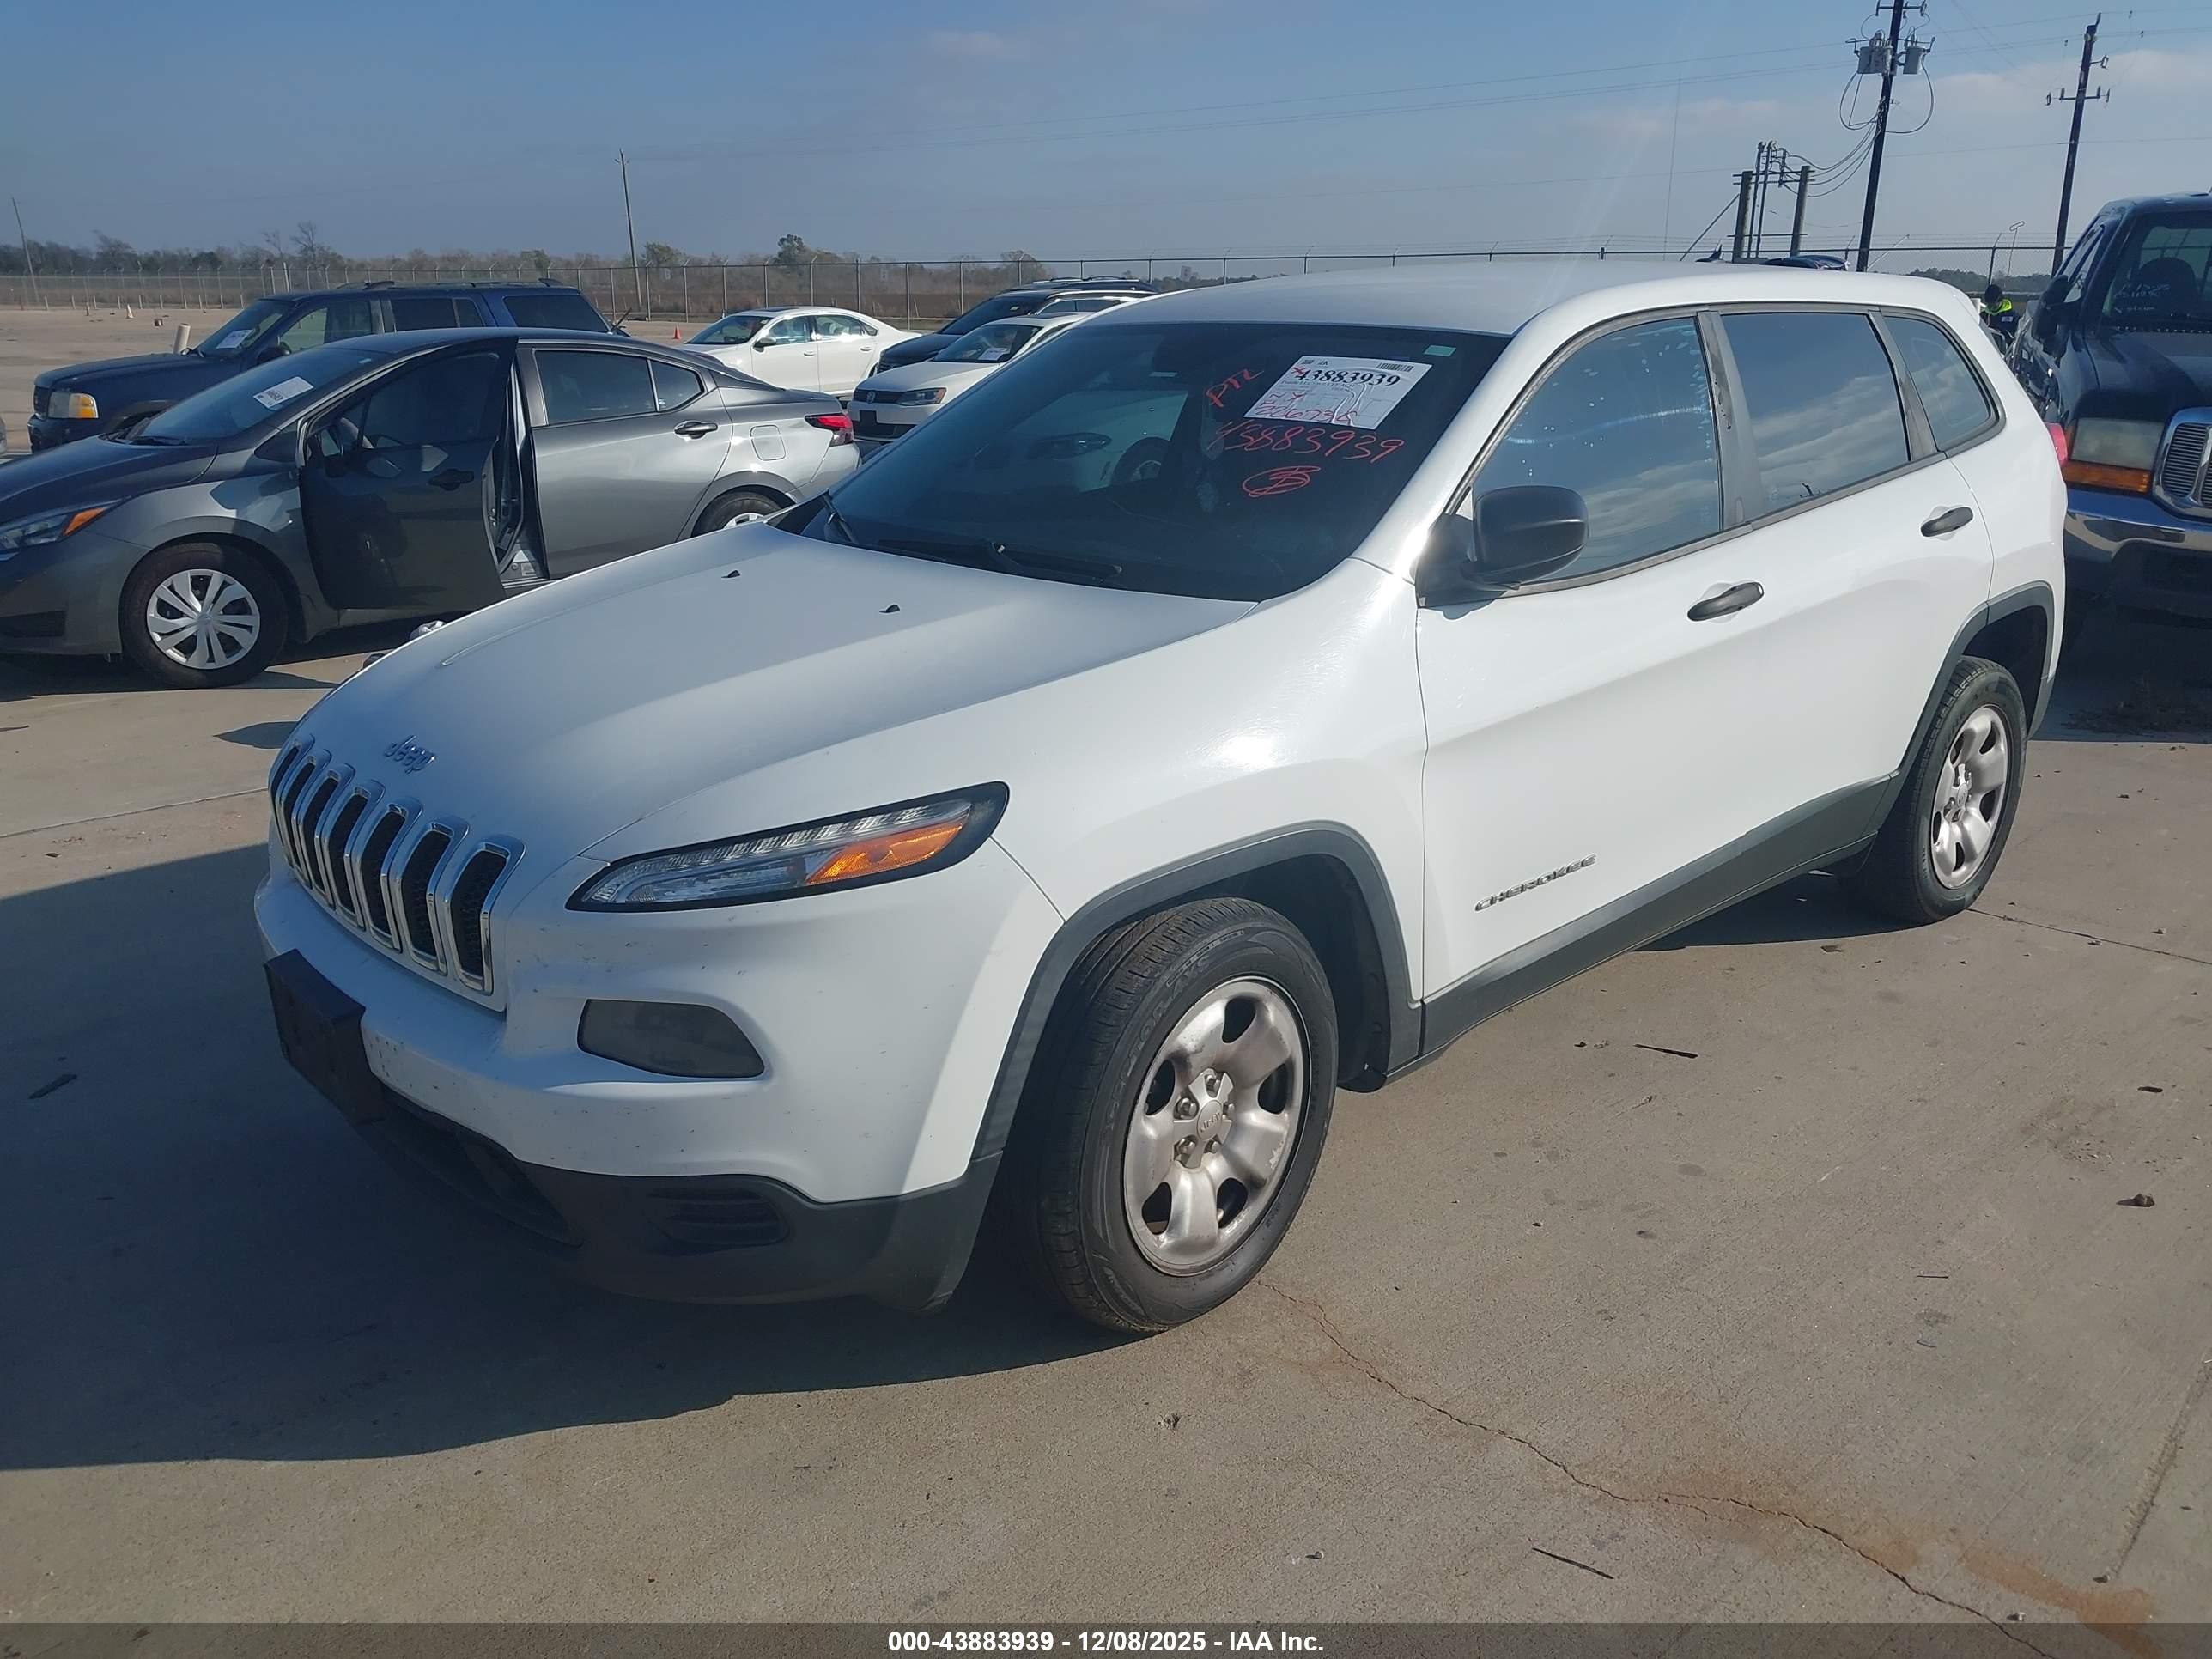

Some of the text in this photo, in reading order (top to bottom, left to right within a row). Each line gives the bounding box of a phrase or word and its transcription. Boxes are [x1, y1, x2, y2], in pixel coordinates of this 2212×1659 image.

[1294, 369, 1401, 387] 43883939
[1206, 419, 1405, 464] 43883939
[384, 735, 435, 774] Jeep
[1474, 854, 1596, 911] CHEROKEE
